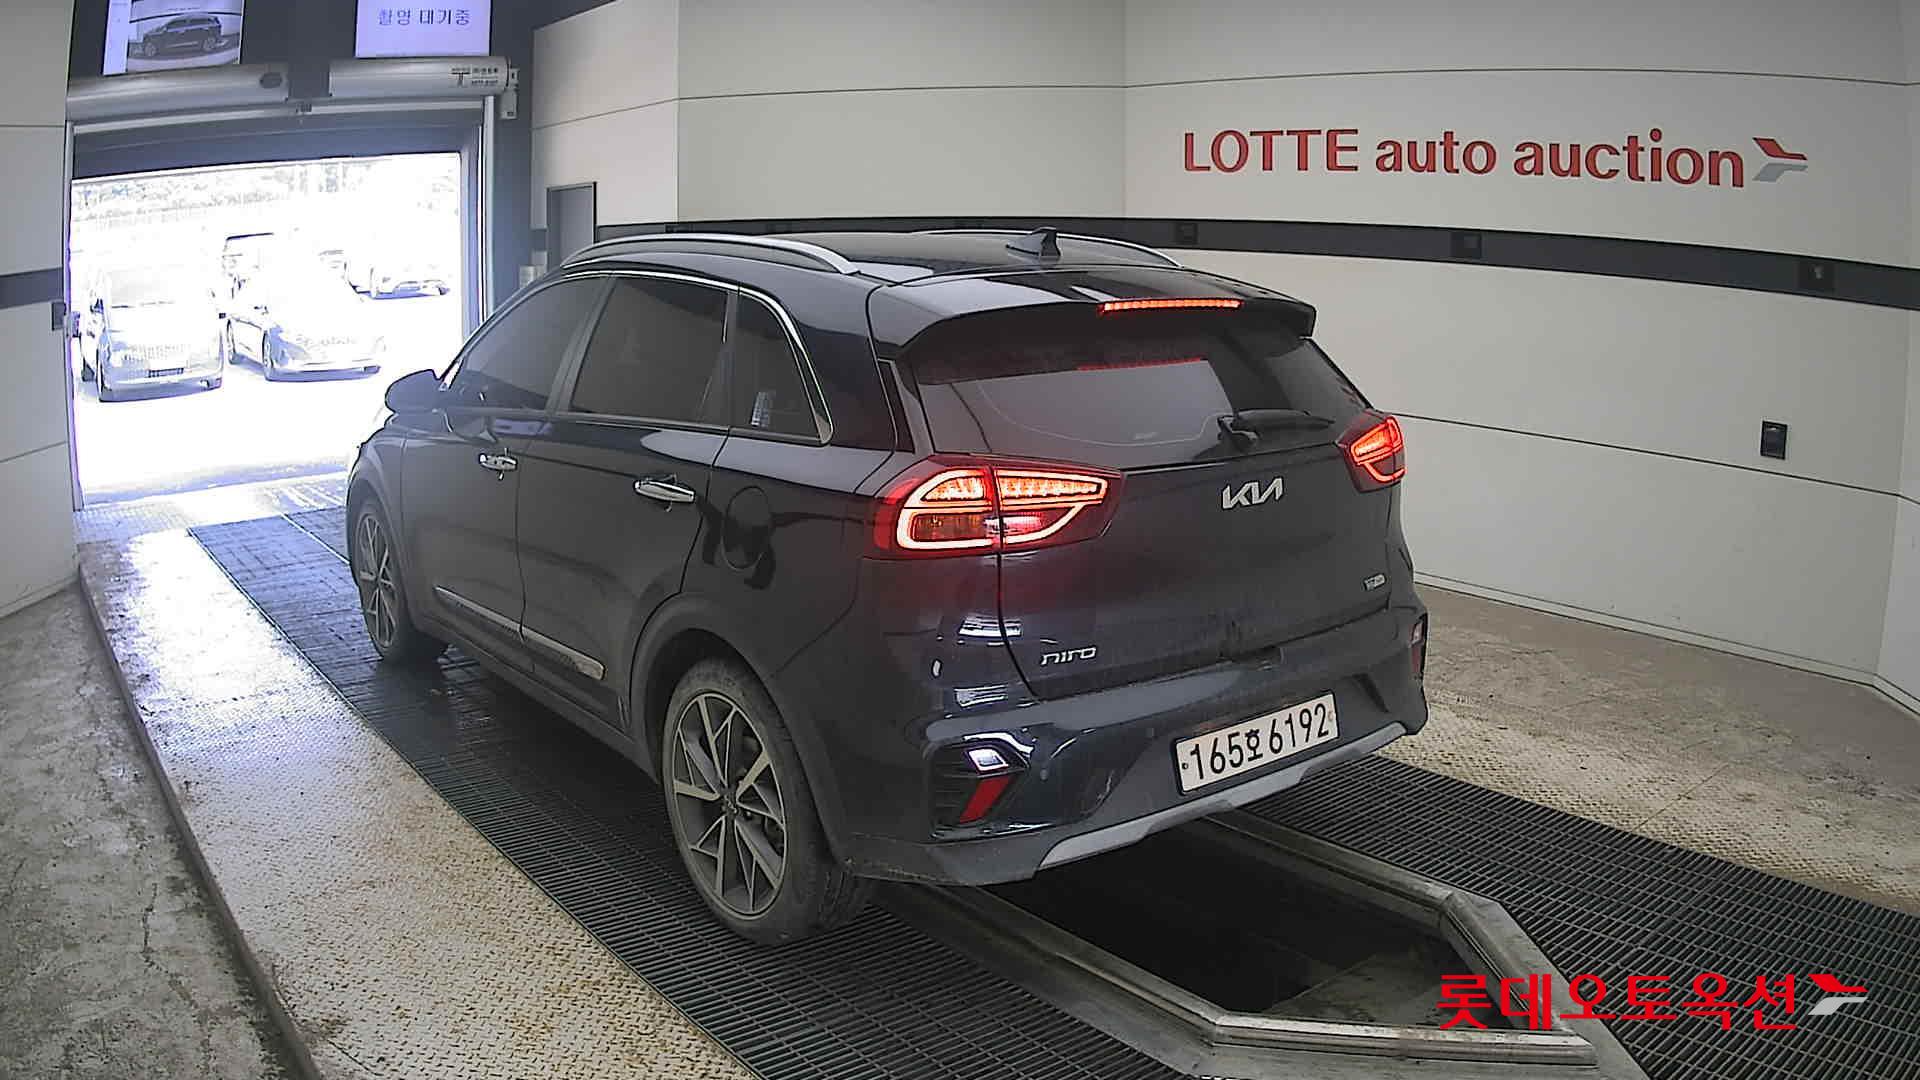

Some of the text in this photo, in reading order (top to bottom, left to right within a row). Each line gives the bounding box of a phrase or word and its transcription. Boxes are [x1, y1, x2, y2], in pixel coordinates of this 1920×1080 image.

[419, 9, 470, 26] 대기중
[1184, 128, 1744, 188] LOTTE auto auction
